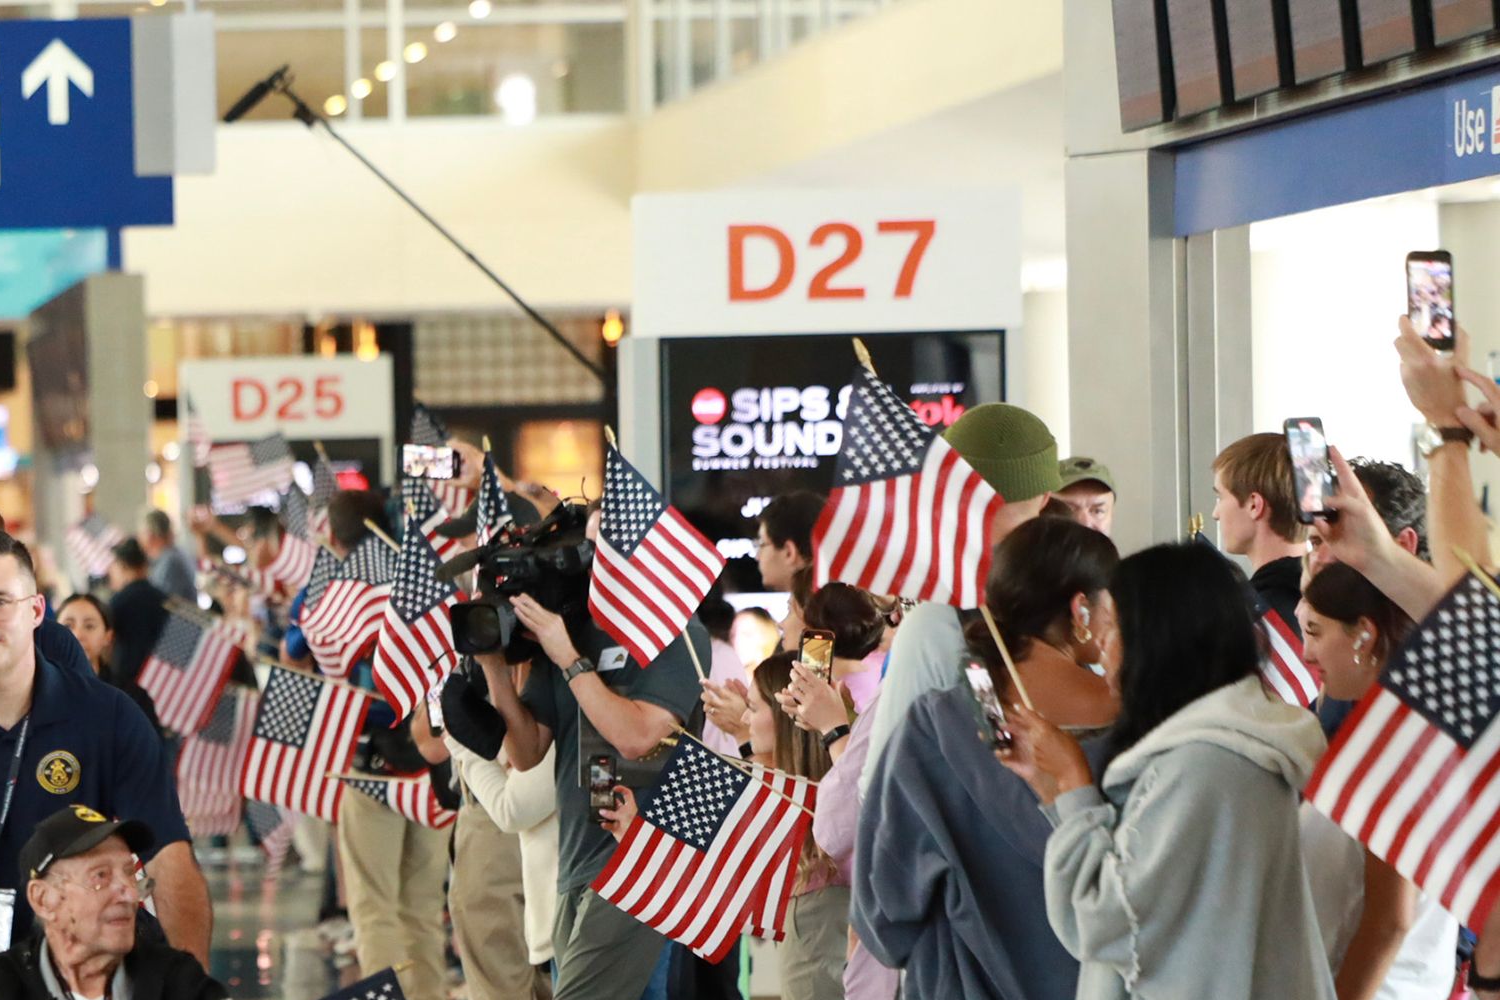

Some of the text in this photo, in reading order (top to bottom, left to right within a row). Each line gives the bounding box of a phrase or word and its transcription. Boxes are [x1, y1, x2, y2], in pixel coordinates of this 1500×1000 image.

[1454, 99, 1485, 158] Use
[727, 220, 935, 303] D27
[231, 374, 344, 422] D25
[731, 385, 830, 423] SIPS
